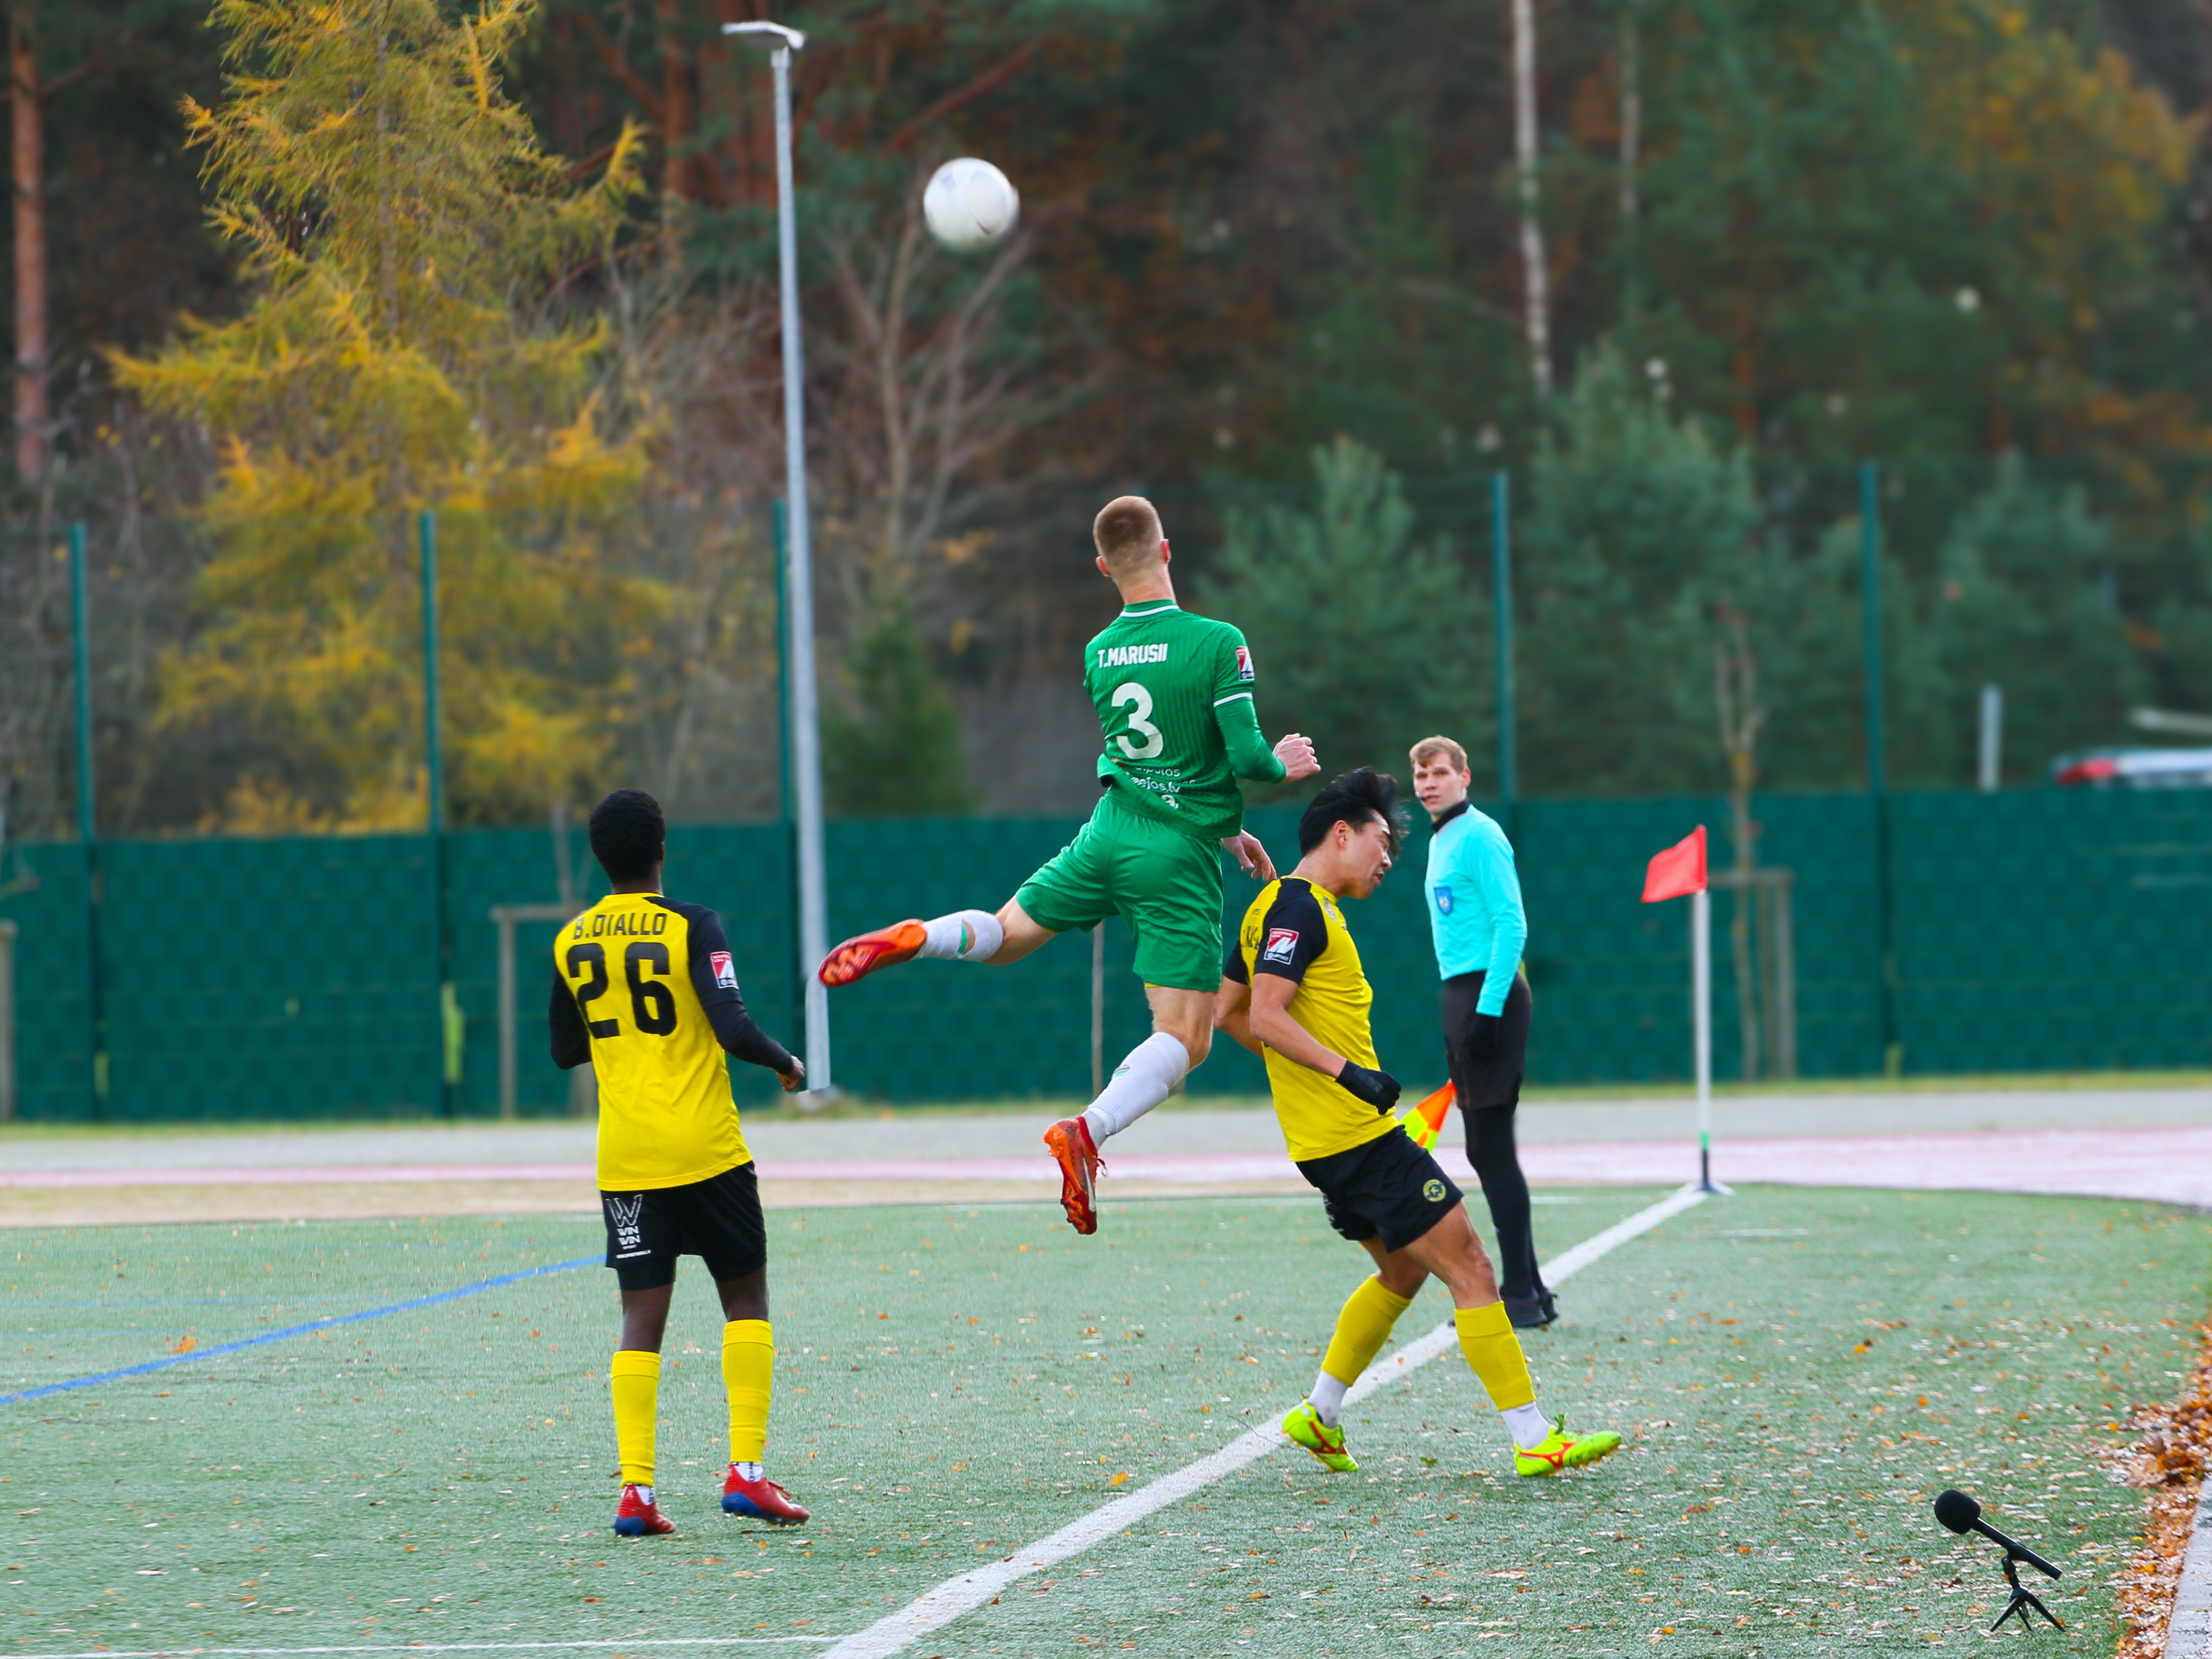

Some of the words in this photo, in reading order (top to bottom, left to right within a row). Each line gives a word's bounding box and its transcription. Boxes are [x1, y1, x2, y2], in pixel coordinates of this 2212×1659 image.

[1098, 643, 1168, 668] T.MARUSII
[1111, 682, 1163, 760] 3
[574, 913, 667, 940] B.DIALLO
[567, 942, 677, 1039] 26
